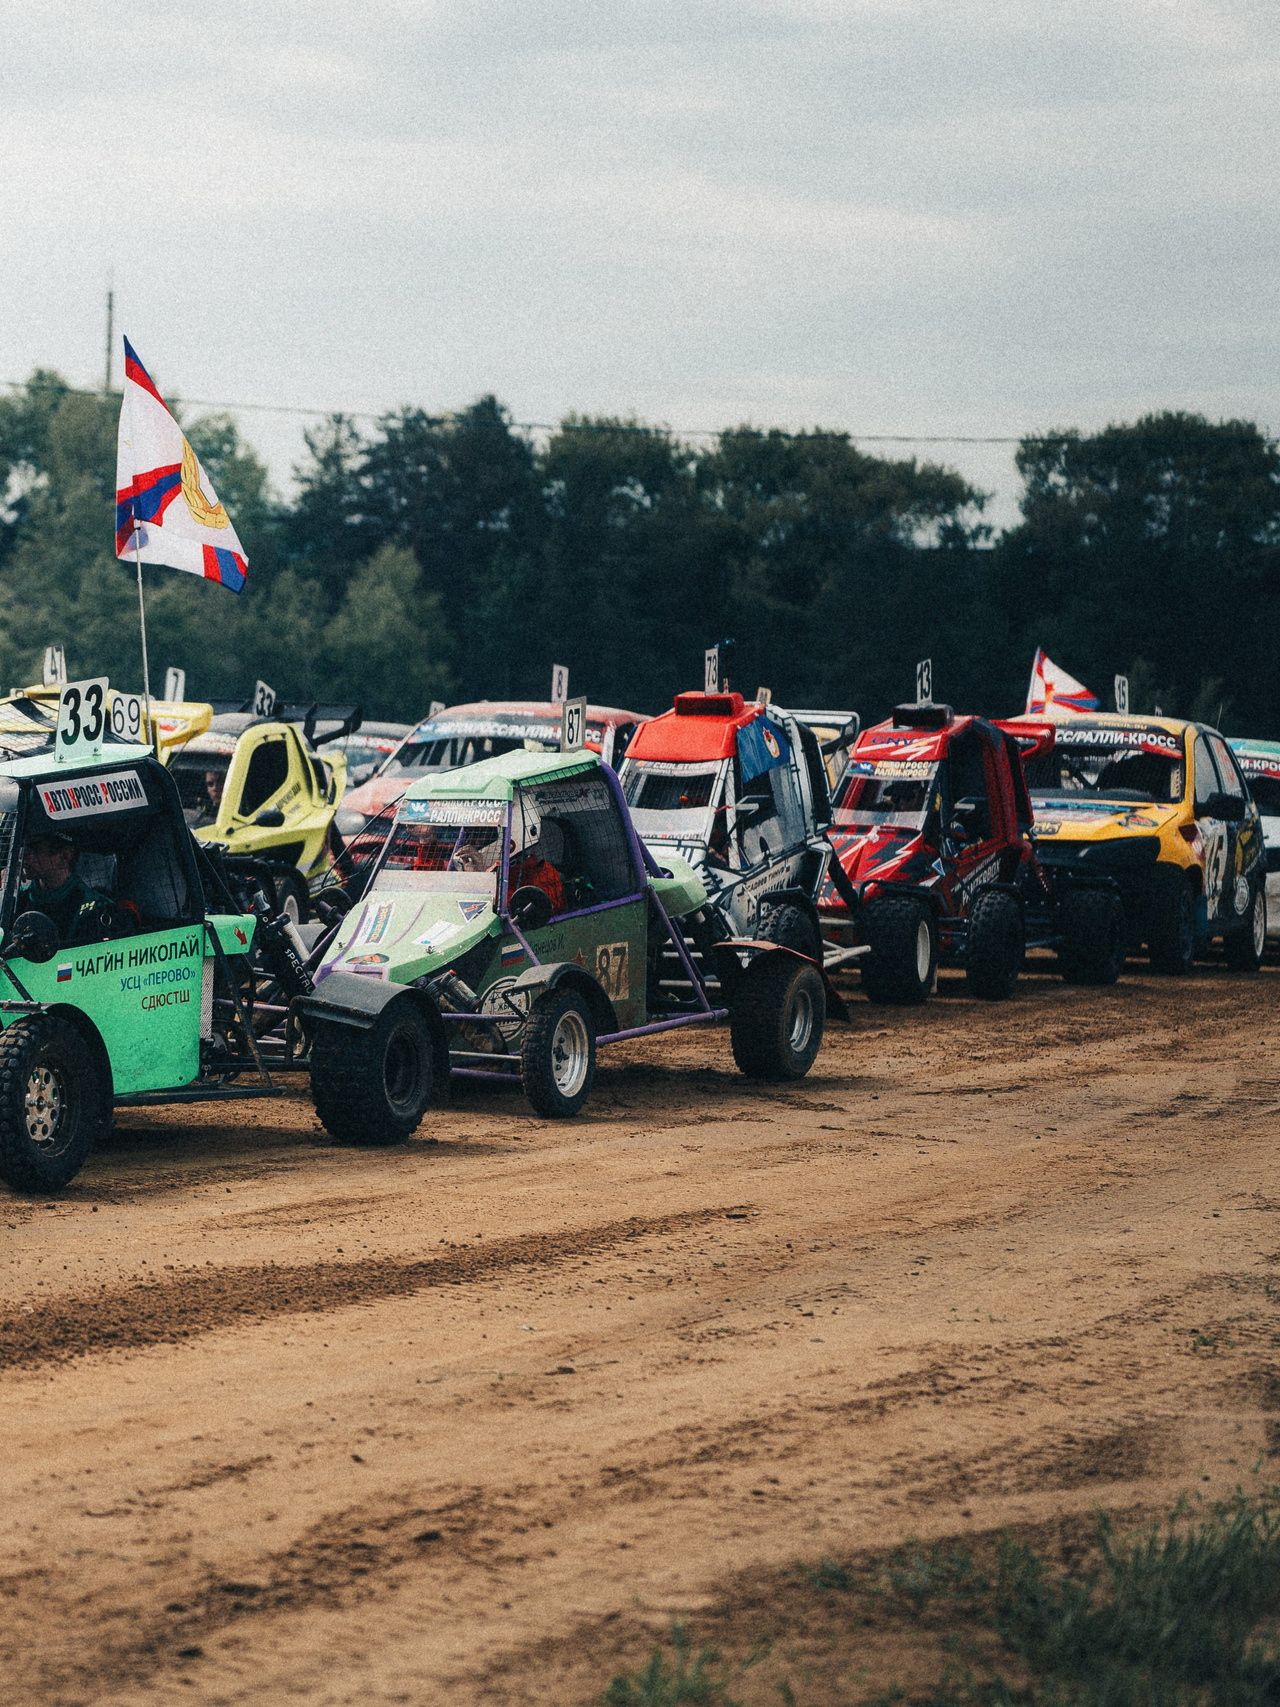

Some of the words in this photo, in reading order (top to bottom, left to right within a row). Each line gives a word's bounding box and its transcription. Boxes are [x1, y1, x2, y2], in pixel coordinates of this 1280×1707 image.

[706, 654, 718, 687] 73
[917, 661, 931, 700] 13
[60, 684, 104, 746] 33
[111, 696, 142, 736] 69
[567, 707, 581, 745] 87
[43, 783, 103, 813] АВТОКРОСС
[100, 777, 144, 805] РОССИИ
[76, 951, 124, 978] ЧАГИН
[128, 934, 199, 968] НИКОЛАЙ
[284, 948, 314, 994] SPECTRU
[598, 946, 627, 998] 87
[121, 975, 142, 992] УСЦ
[143, 967, 196, 987] «ПЕРОВО»
[141, 988, 191, 1012] СДЮСТШ
